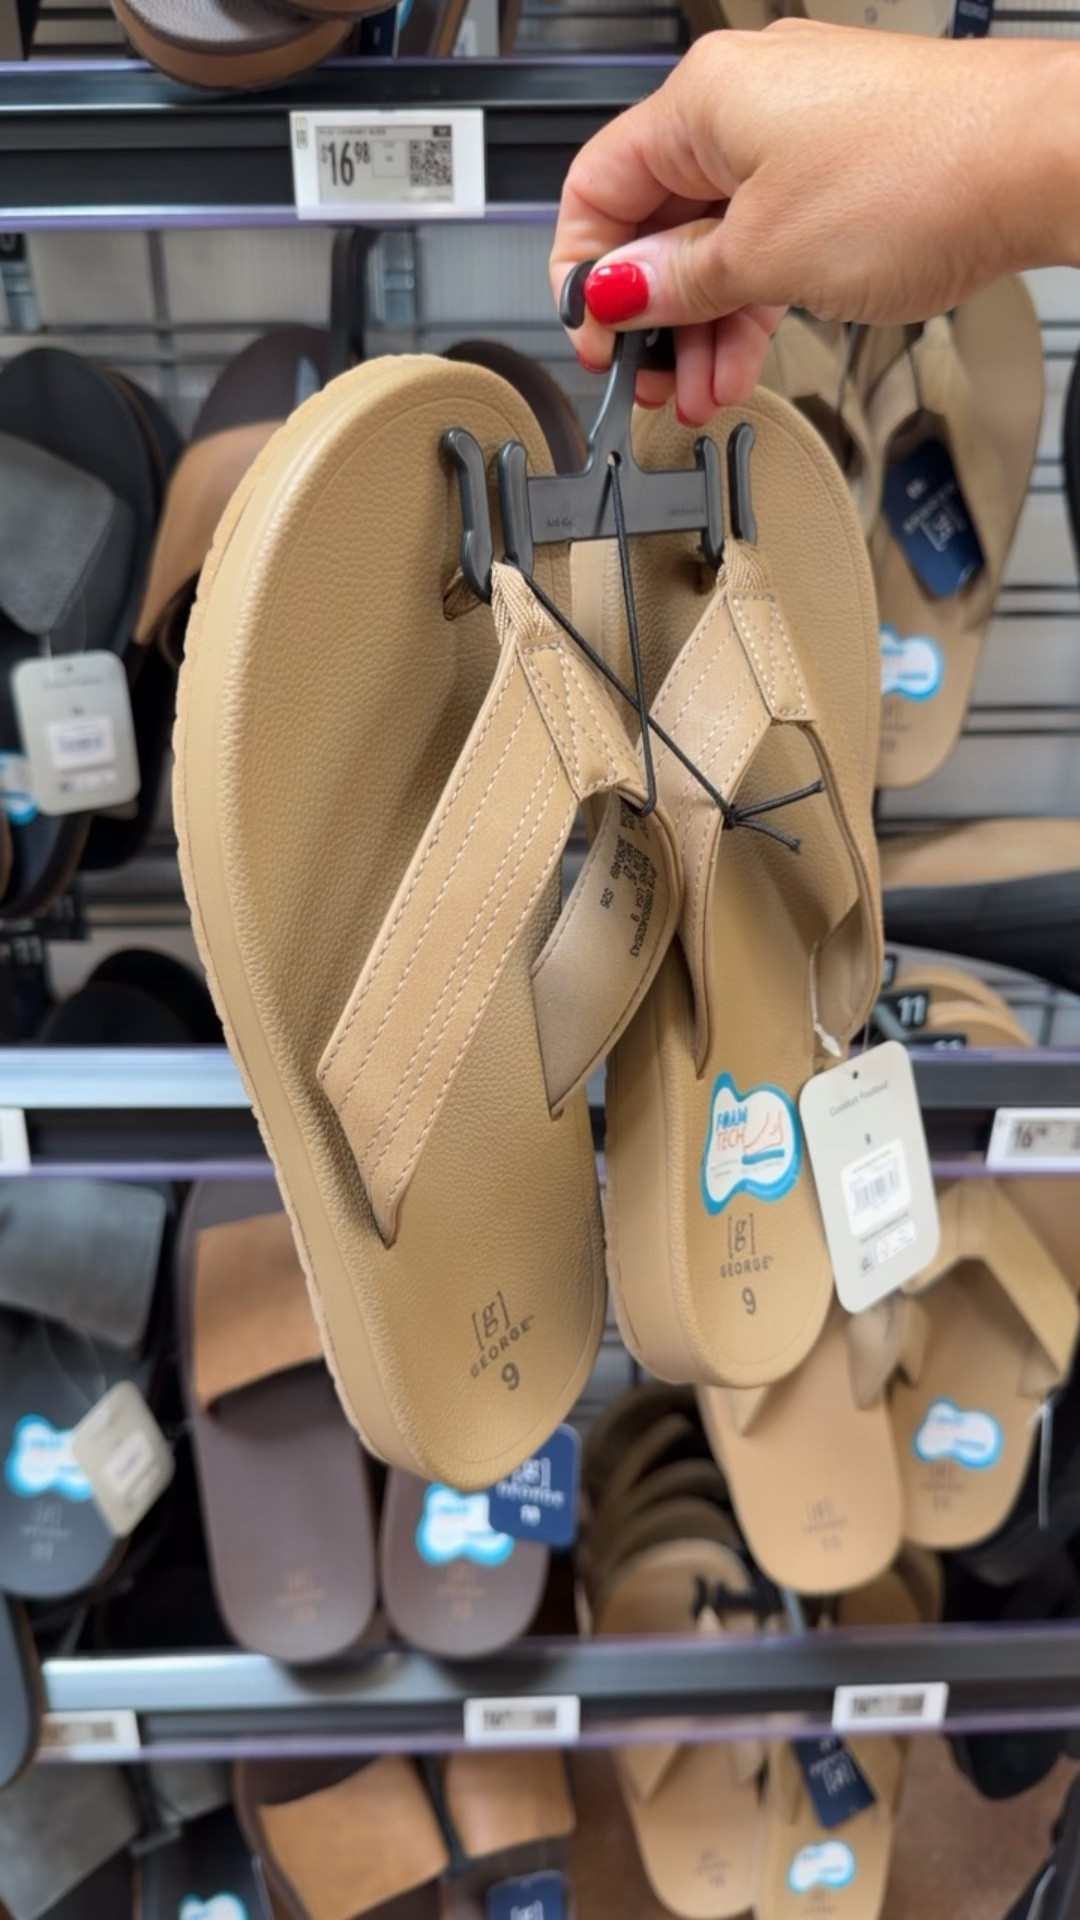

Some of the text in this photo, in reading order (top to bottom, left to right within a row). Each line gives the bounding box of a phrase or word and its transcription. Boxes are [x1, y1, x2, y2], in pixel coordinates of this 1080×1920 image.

[898, 996, 928, 1025] 11
[716, 1106, 748, 1131] FOAM
[714, 1126, 746, 1152] TECH
[720, 1254, 772, 1278] GEORGE
[741, 1286, 757, 1316] 9
[469, 1314, 534, 1380] GEORGE
[501, 1361, 521, 1392] 9
